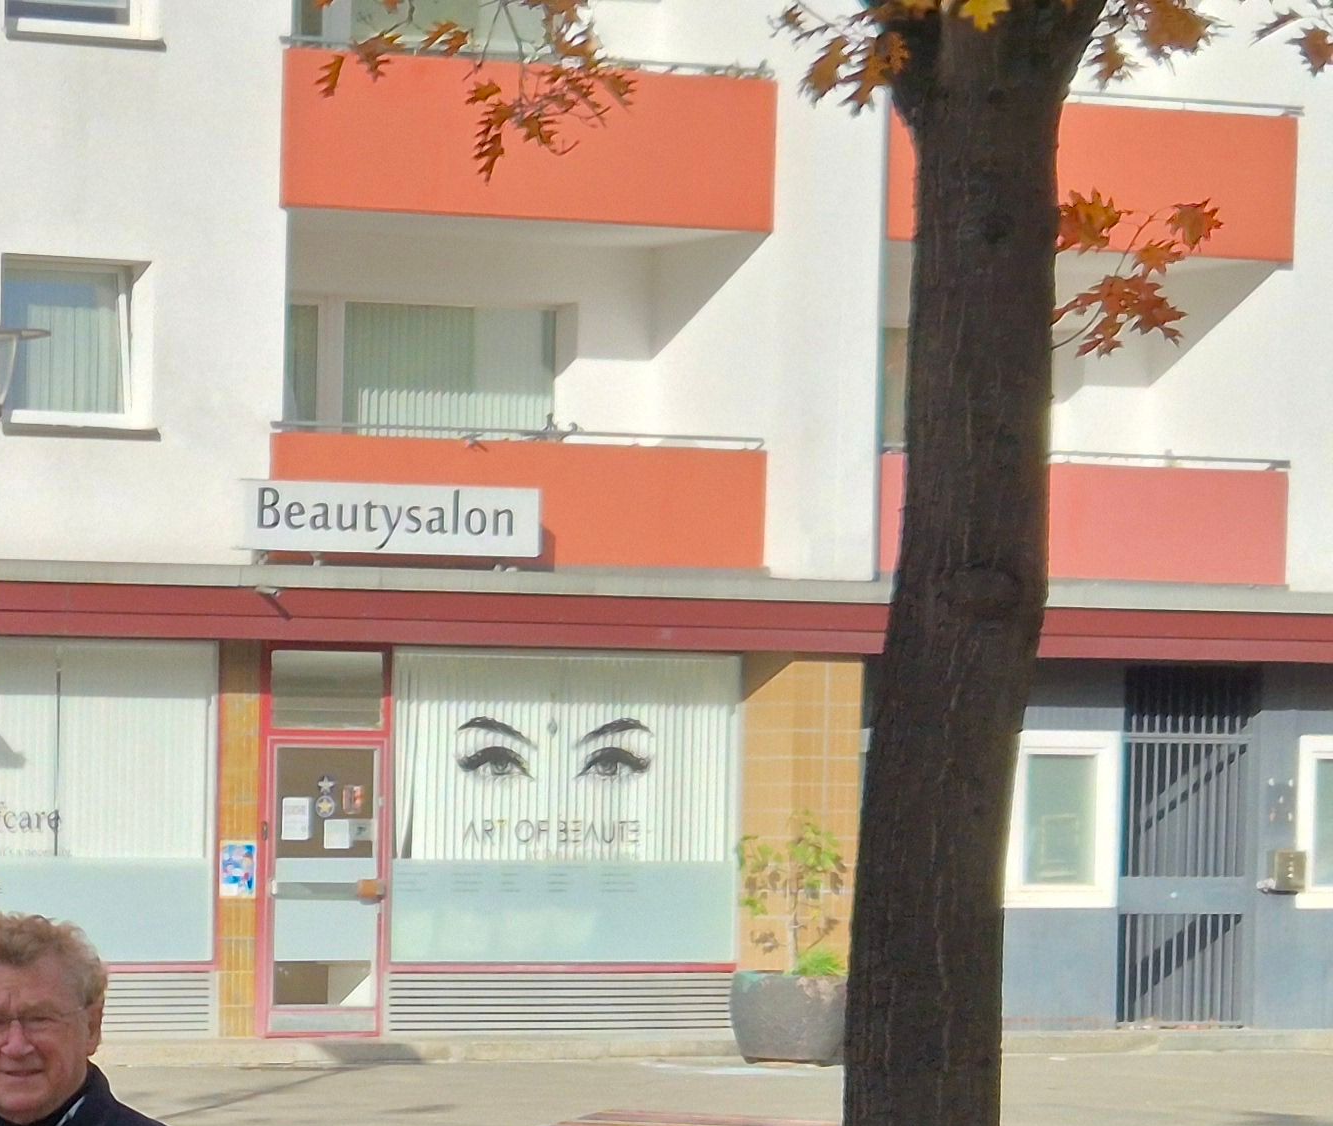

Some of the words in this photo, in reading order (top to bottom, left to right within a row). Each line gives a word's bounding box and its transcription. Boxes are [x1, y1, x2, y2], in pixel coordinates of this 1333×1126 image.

[256, 486, 514, 551] Beautysalon
[462, 819, 507, 845] ART
[515, 819, 550, 843] OF
